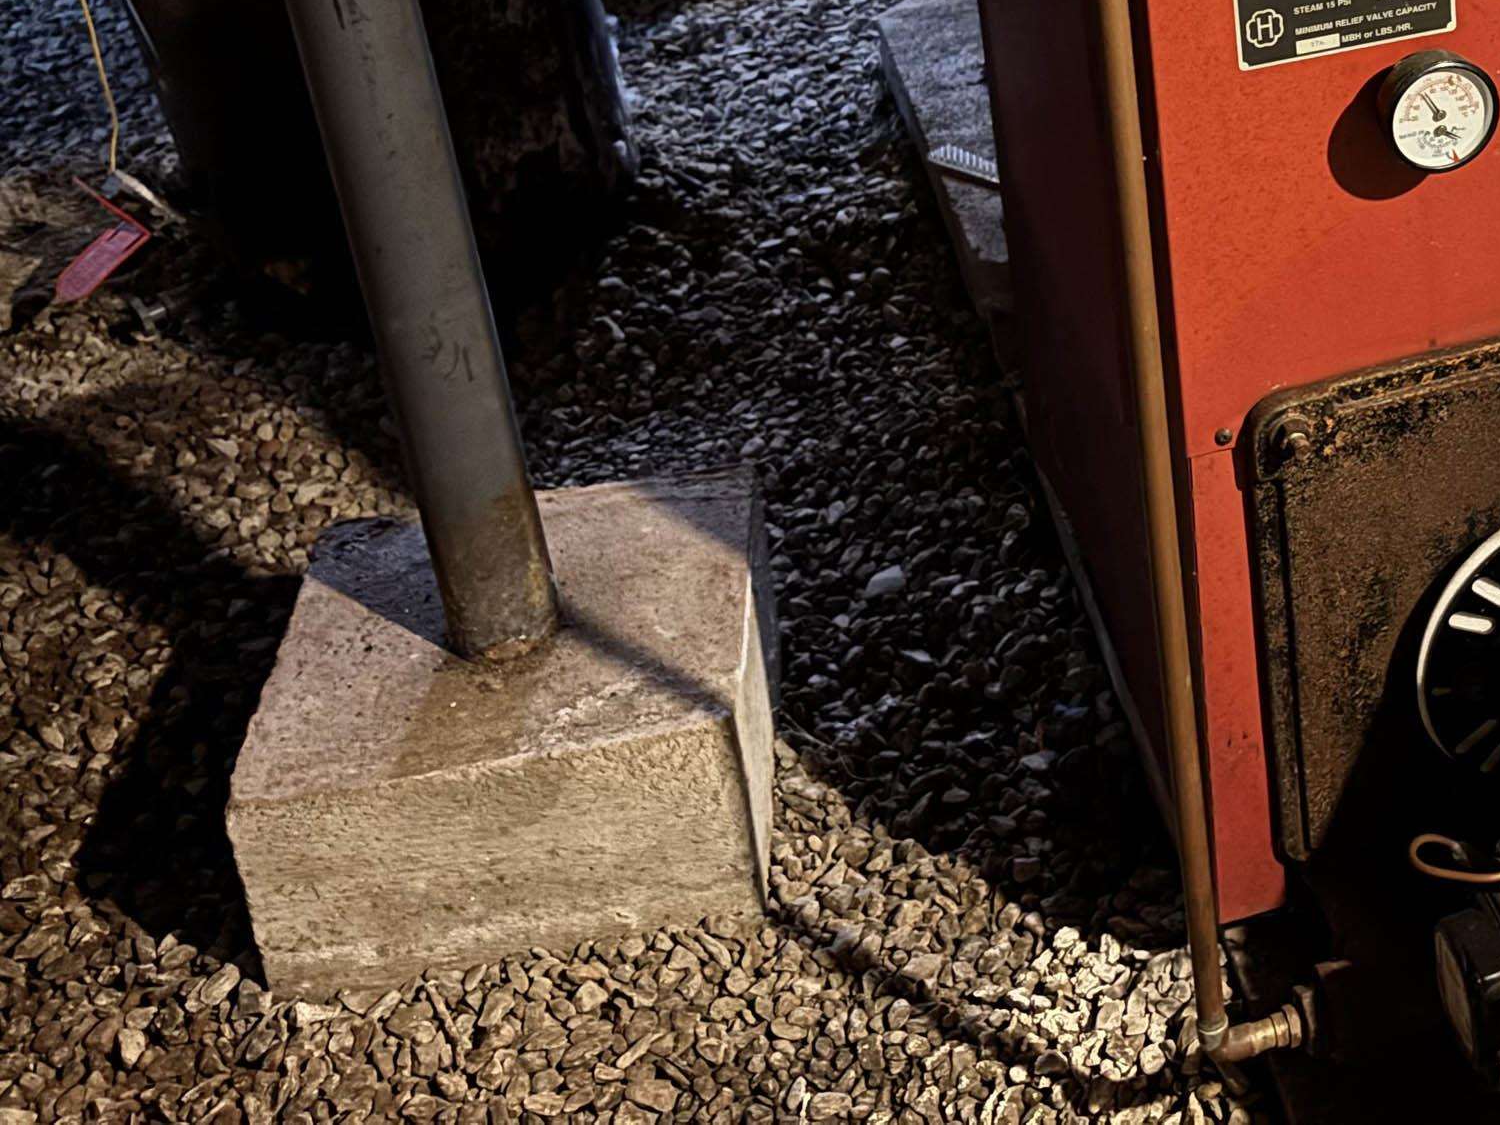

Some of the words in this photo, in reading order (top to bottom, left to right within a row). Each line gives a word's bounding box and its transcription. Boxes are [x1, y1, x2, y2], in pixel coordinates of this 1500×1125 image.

[1293, 4, 1323, 15] STEAM
[1326, 1, 1336, 9] 15
[1295, 21, 1334, 35] MINIMUM
[1335, 16, 1364, 28] RELIEF
[1366, 10, 1393, 22] VALVE
[1396, 2, 1437, 16] CAPACITY
[1341, 32, 1361, 43] MBH
[1364, 31, 1373, 39] or
